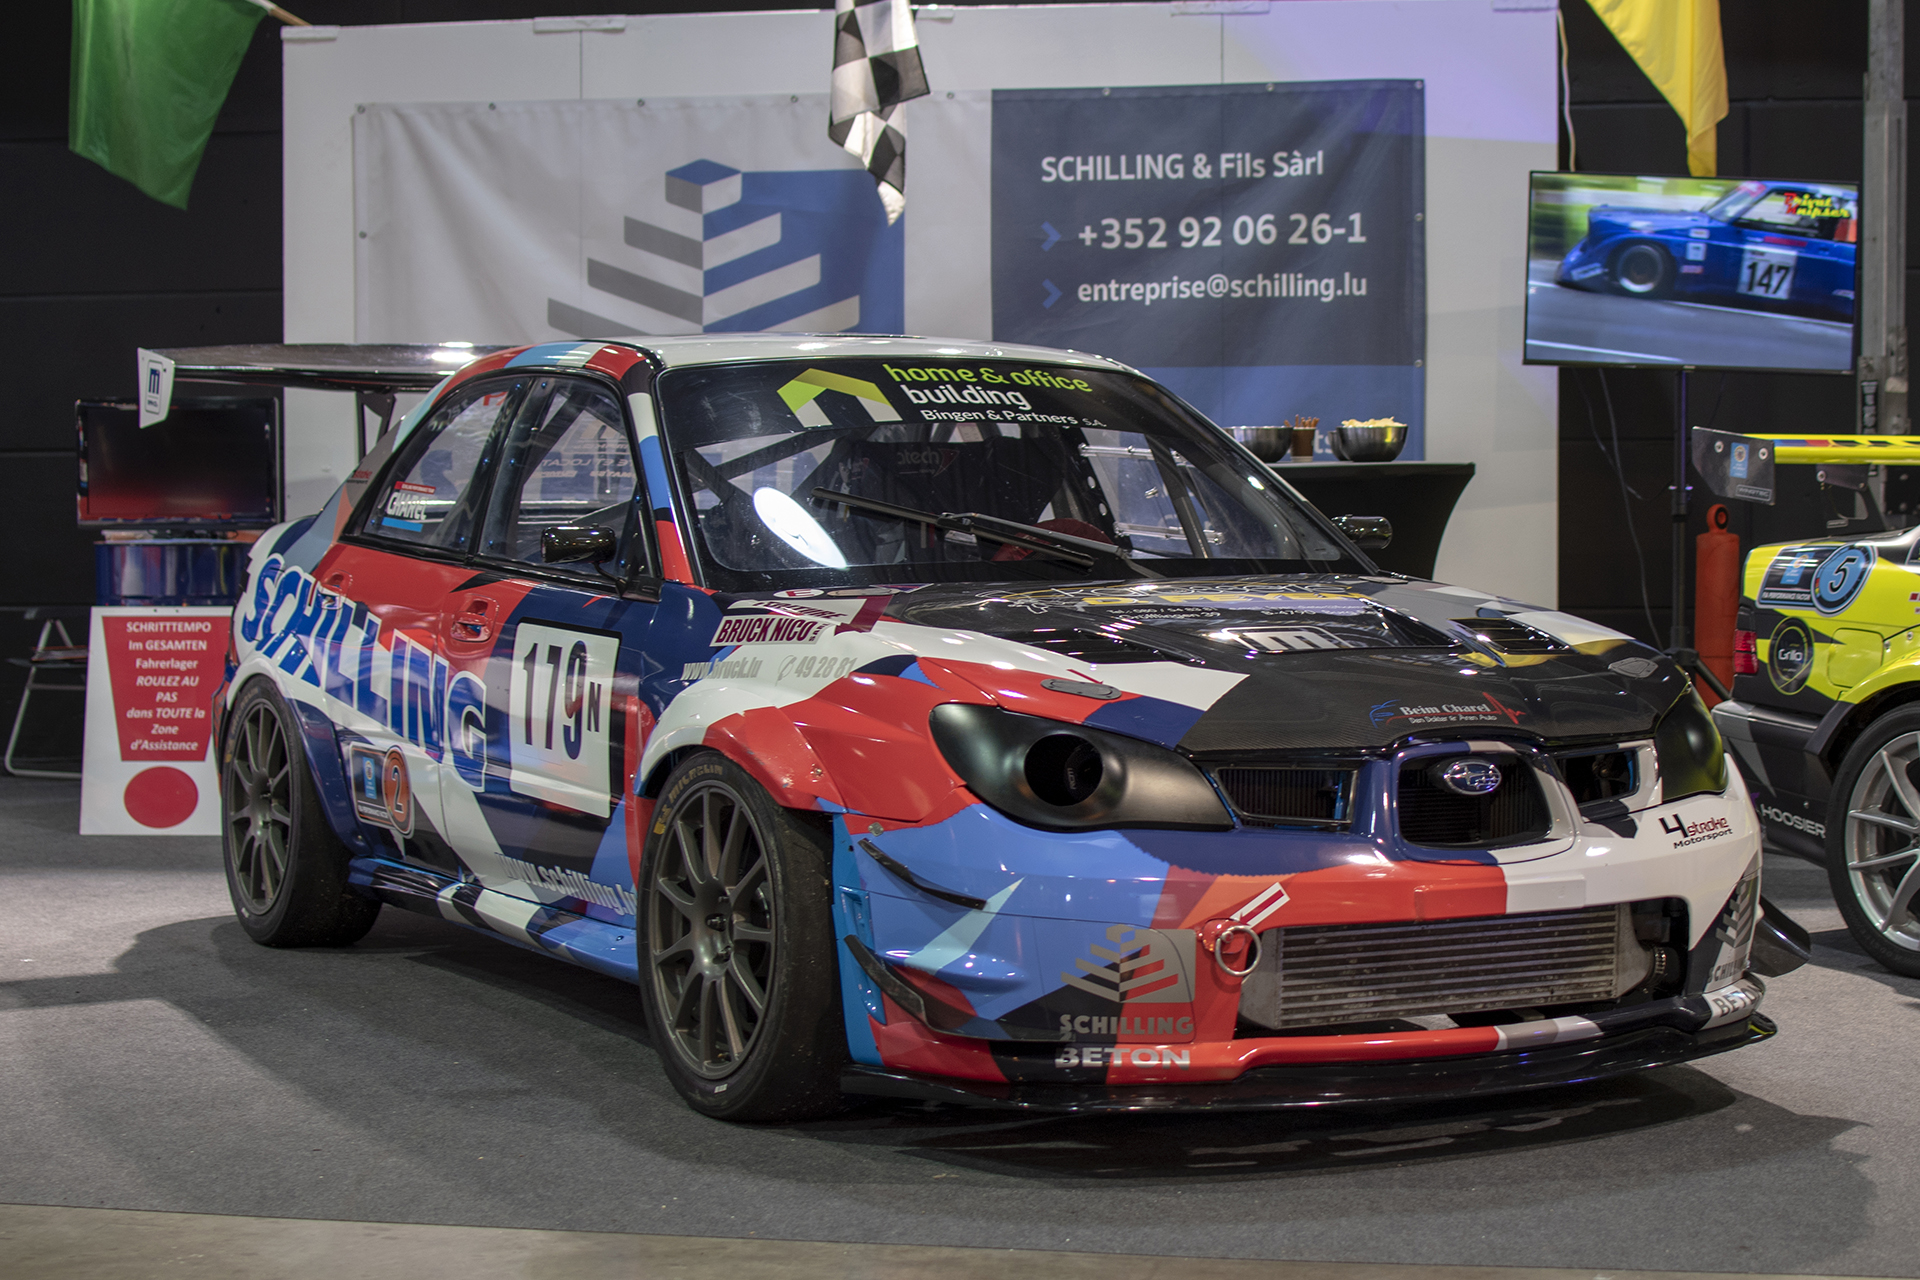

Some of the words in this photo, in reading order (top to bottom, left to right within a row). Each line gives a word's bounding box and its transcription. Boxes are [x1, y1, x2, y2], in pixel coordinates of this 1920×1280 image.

[1041, 153, 1184, 182] SCHILLING
[1192, 153, 1212, 180] &
[1220, 152, 1266, 179] Fils
[1272, 150, 1324, 178] Sàrl
[1078, 217, 1168, 249] +352
[1178, 215, 1222, 248] 92
[1232, 213, 1277, 246] 06
[1288, 212, 1367, 245] 26-1
[1077, 272, 1367, 305] entreprise@schilling.lu
[1747, 261, 1791, 295] 147
[882, 363, 978, 384] home
[979, 367, 1011, 385] &
[1010, 369, 1093, 393] office
[900, 384, 1033, 411] building
[920, 410, 986, 422] Bingen
[985, 410, 1003, 422] &
[1002, 410, 1079, 426] Partners
[1829, 555, 1859, 594] 5
[126, 621, 212, 633] SCHRITTTEMPO
[715, 618, 776, 644] BRUCK
[769, 618, 818, 643] NICO
[128, 640, 143, 651] Im
[145, 640, 208, 651] GESAMTEN
[135, 657, 198, 671] Fahrerlager
[240, 552, 488, 794] SCHILLING
[680, 656, 764, 682] www.bruck.lu
[794, 655, 814, 679] 49
[817, 656, 836, 679] 28
[834, 656, 858, 679] 81
[136, 676, 180, 687] ROULEZ
[181, 676, 199, 687] AU
[155, 692, 178, 703] PAS
[523, 640, 588, 760] 179
[587, 681, 602, 733] N
[1400, 705, 1441, 715] Beim
[1441, 703, 1492, 713] Charel
[126, 707, 153, 719] dans
[156, 708, 193, 719] TOUTE
[194, 707, 205, 719] la
[151, 724, 179, 735] Zone
[130, 739, 198, 751] d'Assistance
[391, 765, 405, 814] 2
[668, 764, 723, 804] MICHELIN
[1760, 803, 1827, 839] HOOSIER
[1673, 827, 1733, 849] Motorsport
[1059, 1014, 1194, 1036] SCHILLING
[1055, 1047, 1191, 1071] BETON
